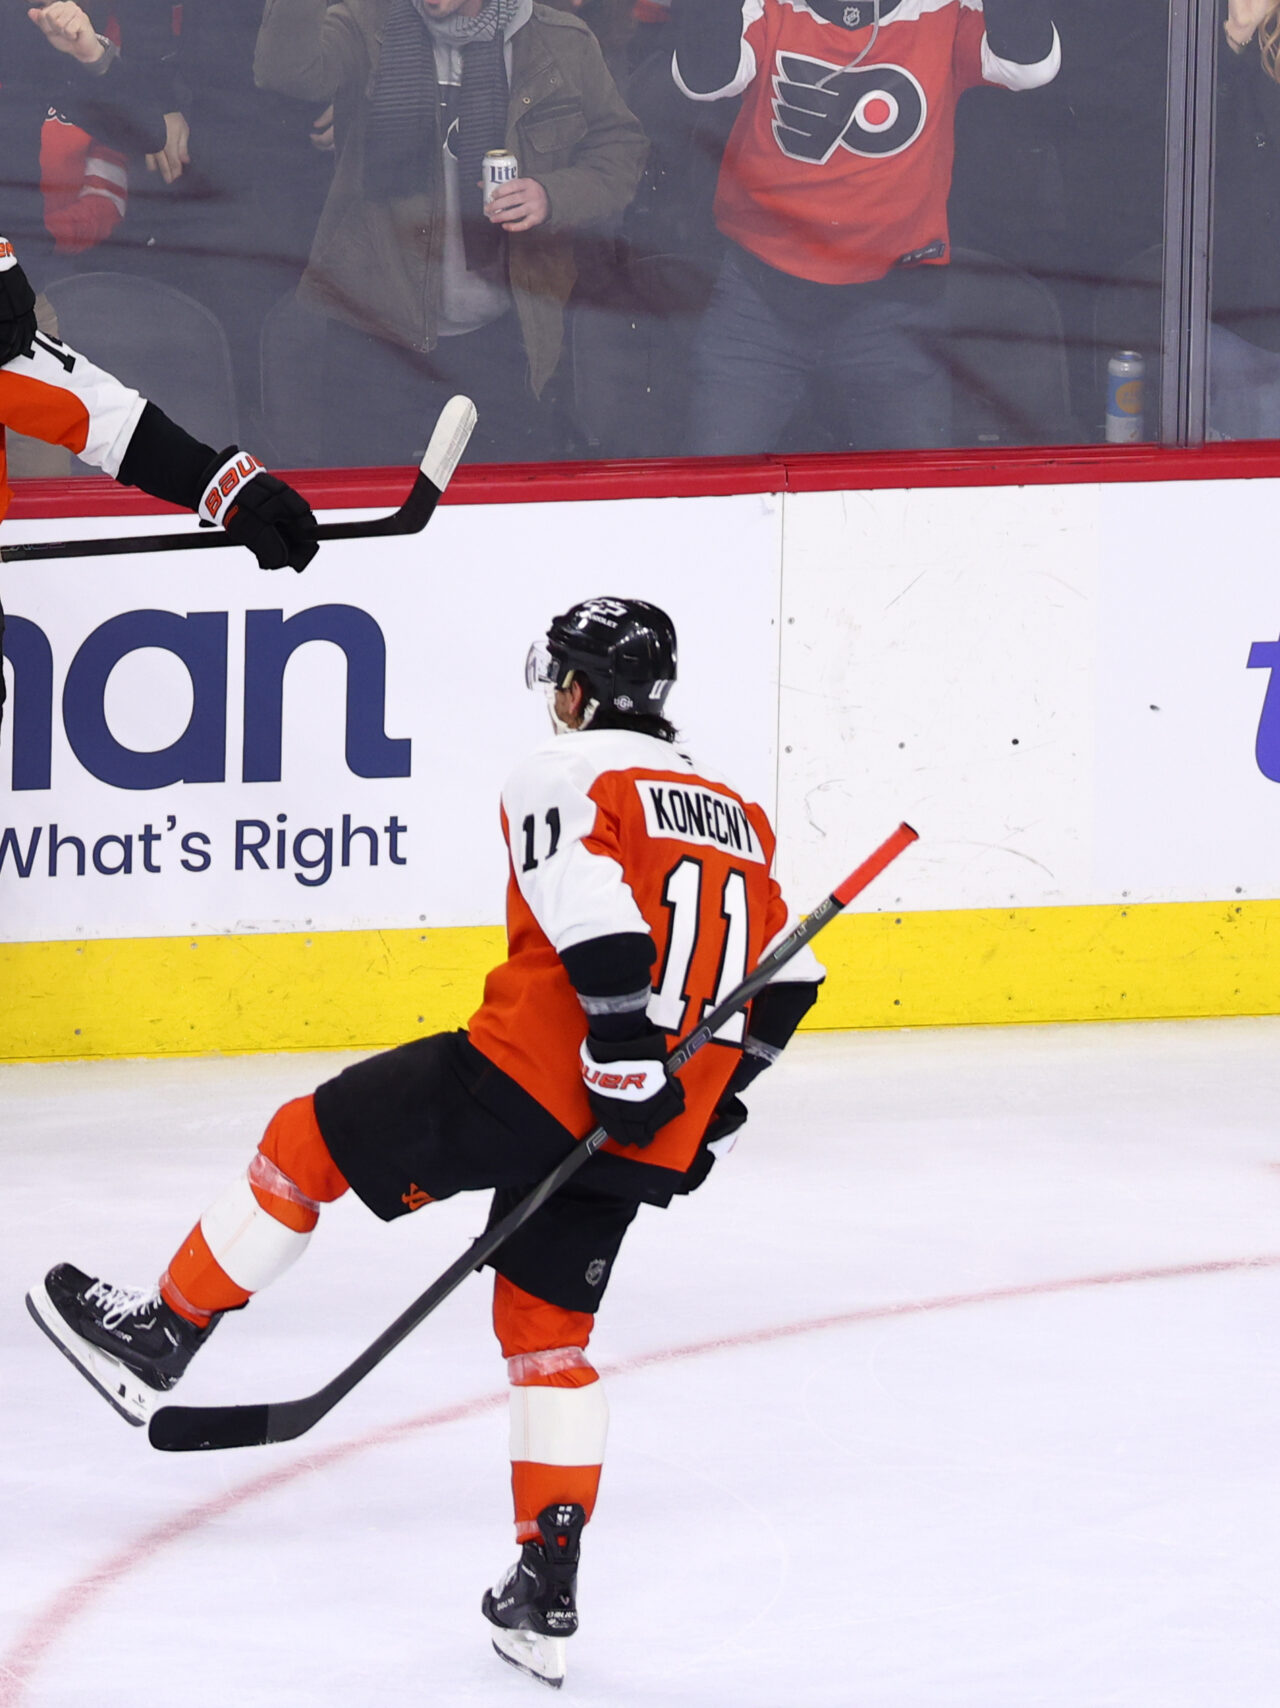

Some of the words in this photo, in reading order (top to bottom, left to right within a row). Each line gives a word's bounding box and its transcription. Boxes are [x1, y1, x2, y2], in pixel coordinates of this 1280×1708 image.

[234, 813, 408, 887] Right
[522, 806, 562, 873] 11
[649, 787, 754, 854] KONECNY
[645, 853, 750, 1049] 11
